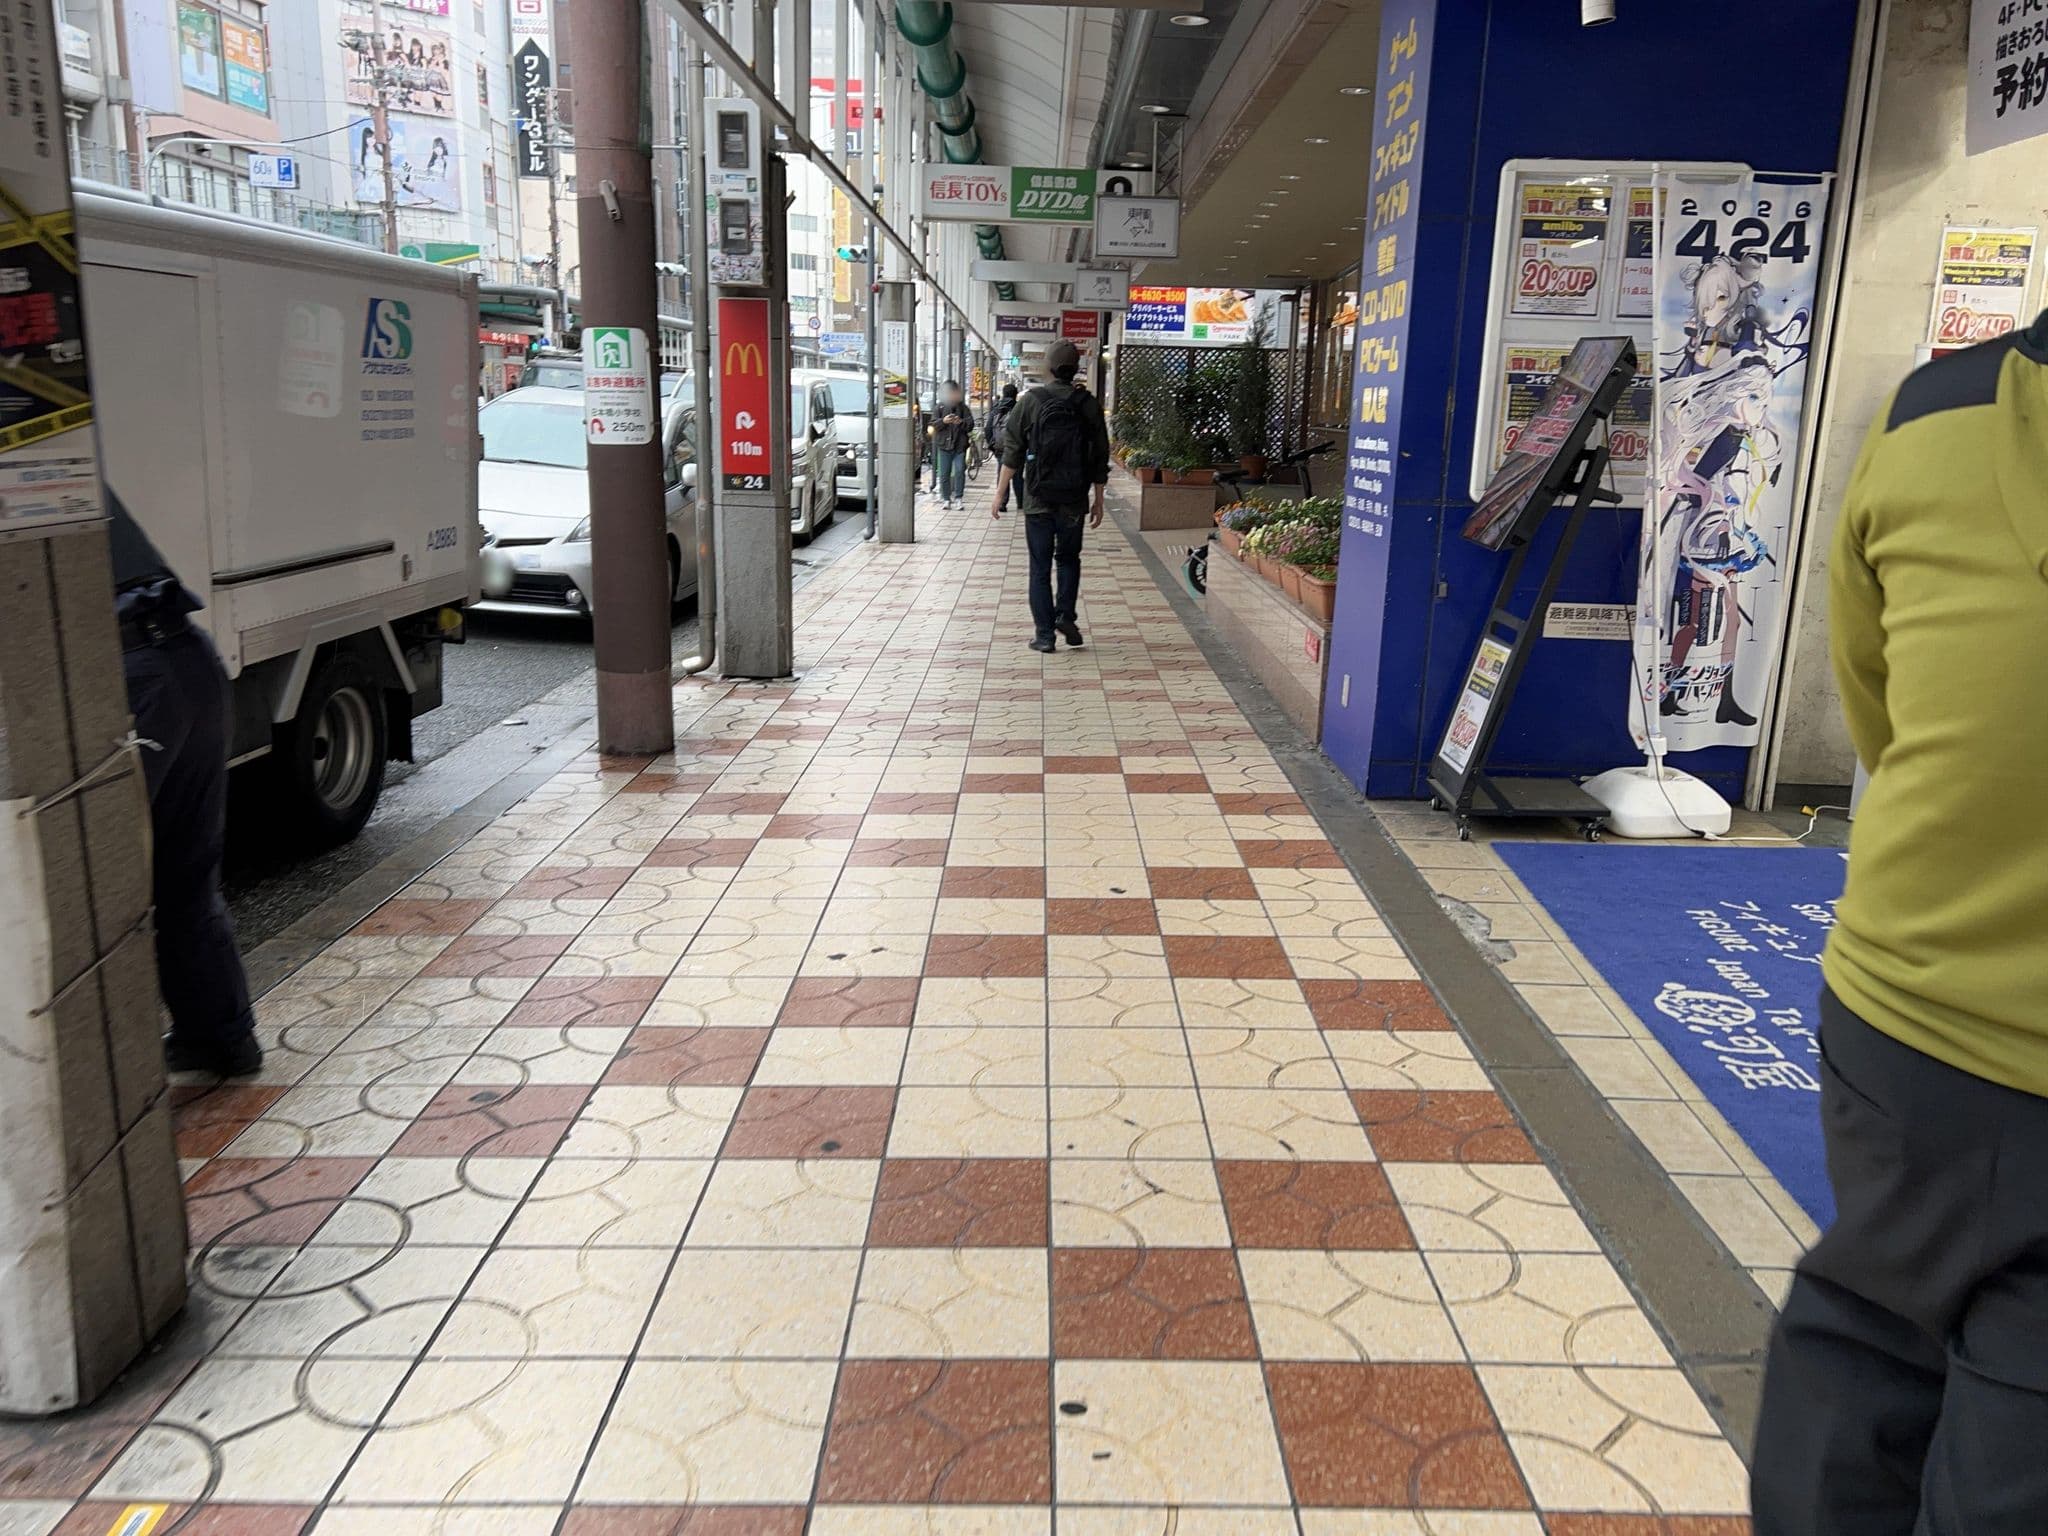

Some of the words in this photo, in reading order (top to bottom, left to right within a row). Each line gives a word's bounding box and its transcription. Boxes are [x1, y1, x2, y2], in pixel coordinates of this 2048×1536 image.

[1542, 221, 1584, 232] amiibo
[1521, 261, 1595, 294] 20%UP
[1027, 316, 1057, 330] Guf
[612, 421, 647, 432] 250m
[731, 440, 763, 456] 110m
[744, 475, 764, 489] 24
